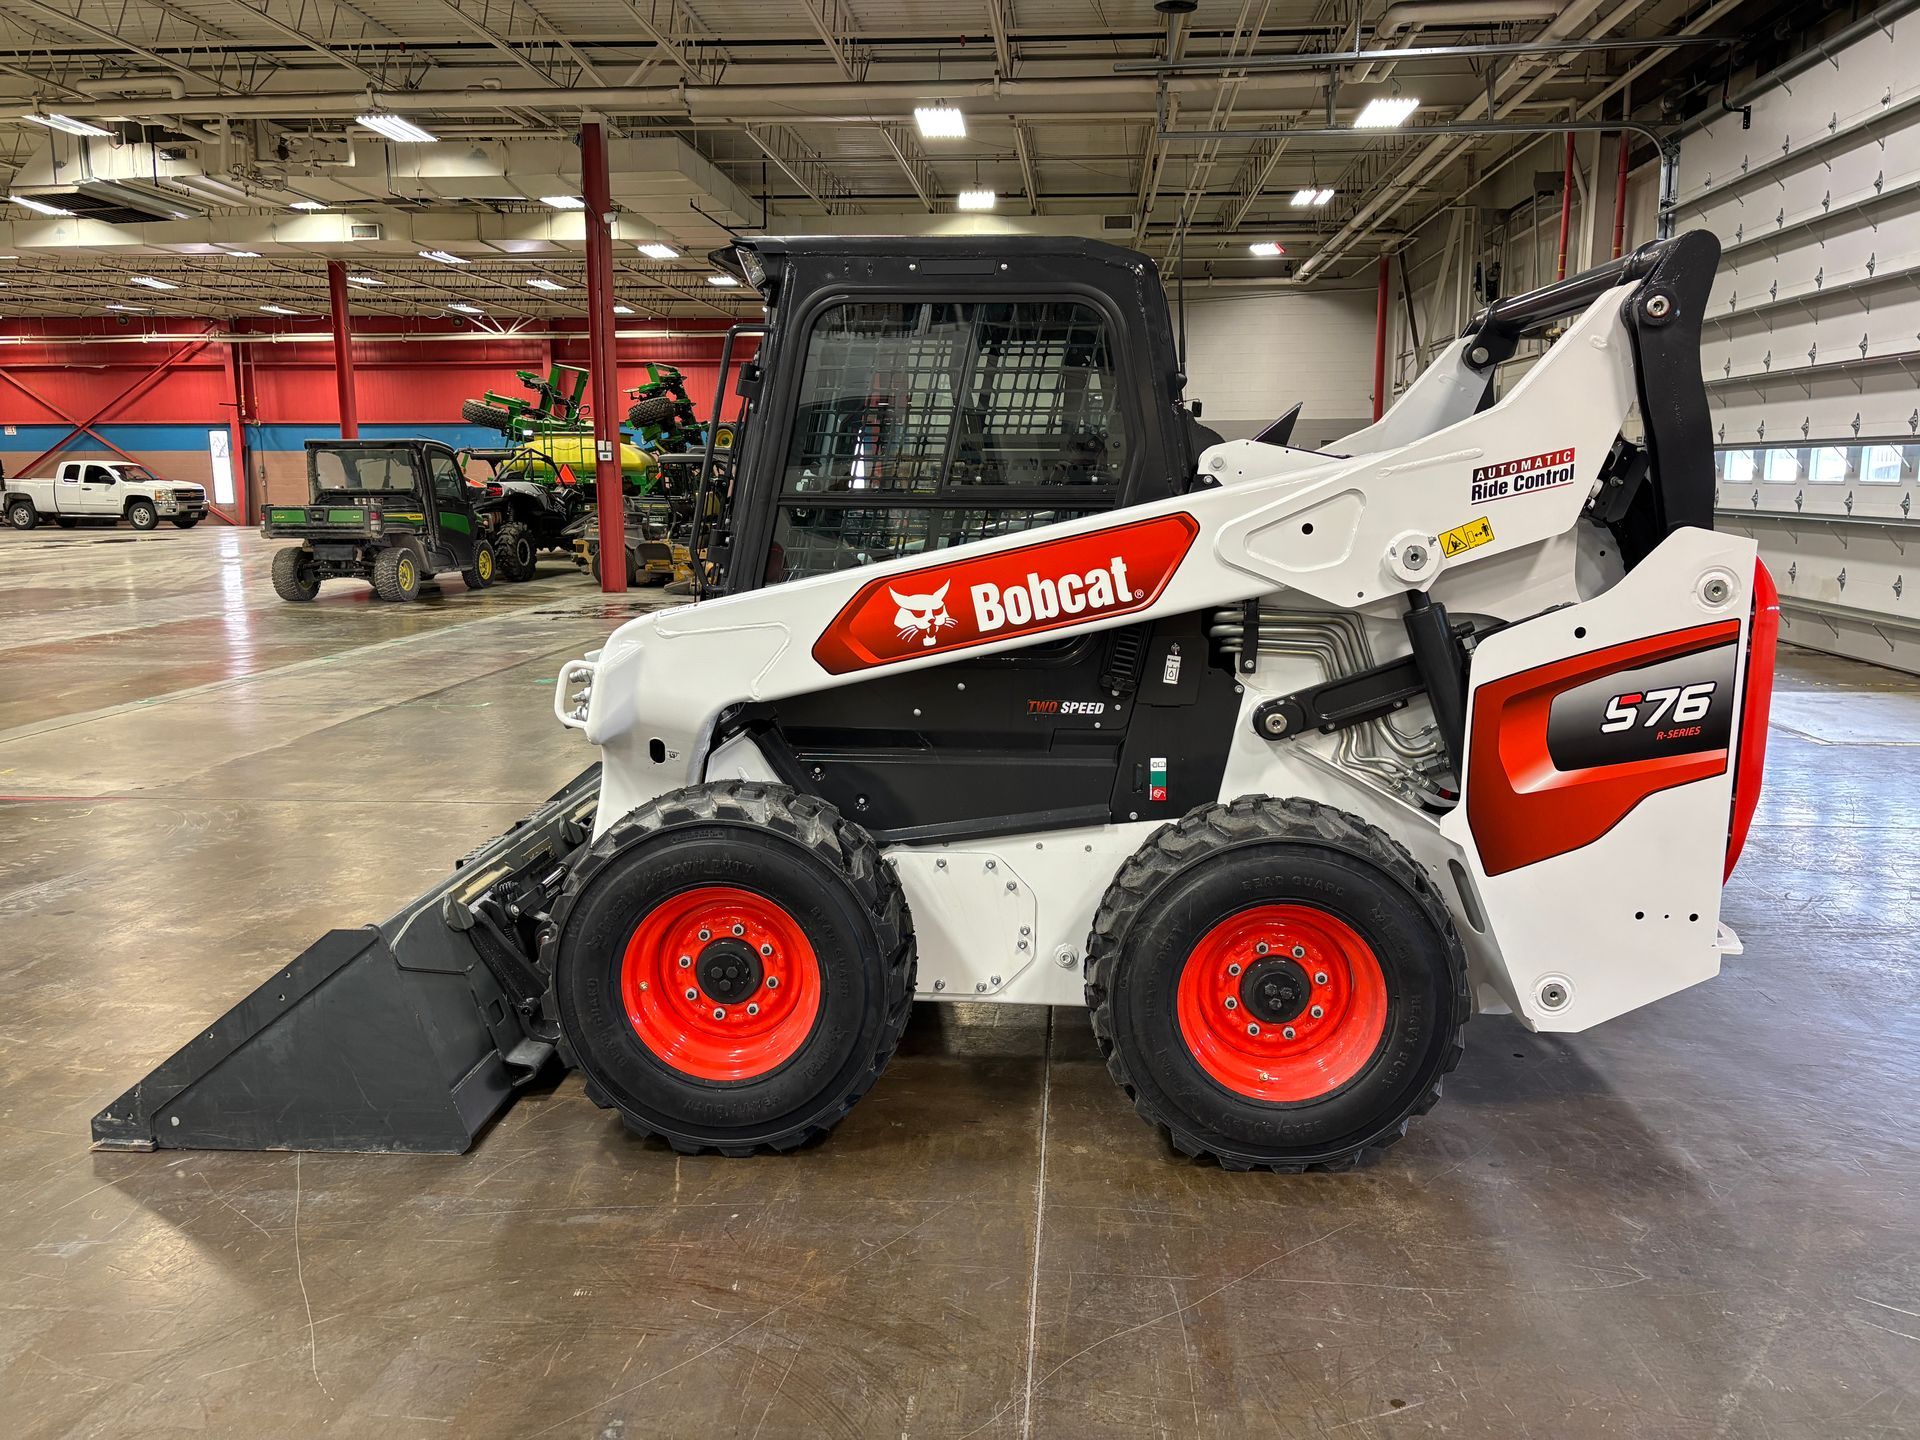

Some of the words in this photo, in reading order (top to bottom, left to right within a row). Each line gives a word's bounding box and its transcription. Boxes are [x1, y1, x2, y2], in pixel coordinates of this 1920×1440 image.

[1476, 451, 1572, 480] AUTOMATIC
[1471, 478, 1508, 501] Ride
[1514, 464, 1575, 492] Control
[1028, 700, 1058, 714] TWO
[1060, 701, 1104, 715] SPEED
[1600, 681, 1717, 734] S76
[1656, 726, 1702, 740] R-SERIES
